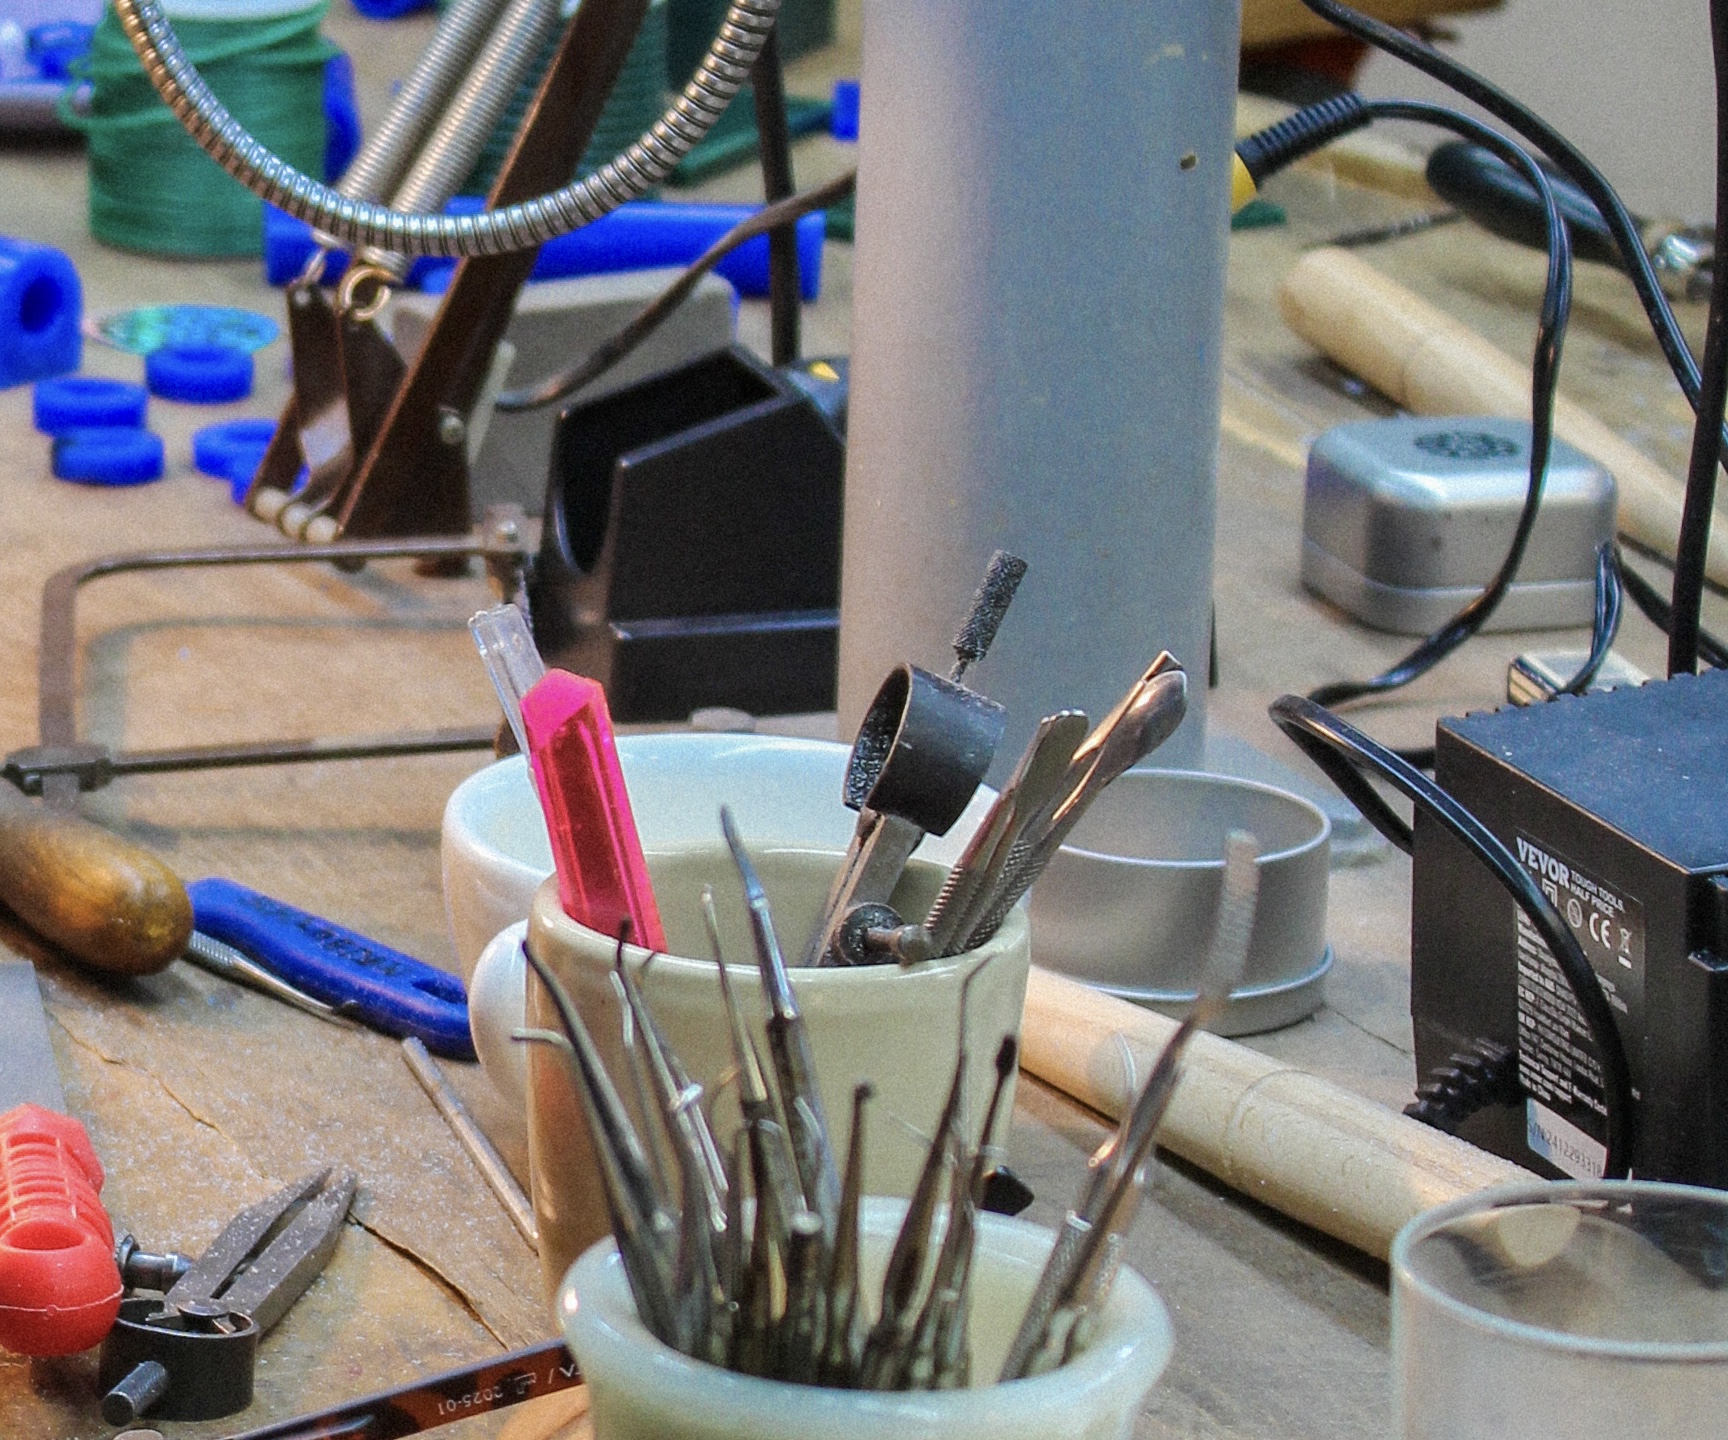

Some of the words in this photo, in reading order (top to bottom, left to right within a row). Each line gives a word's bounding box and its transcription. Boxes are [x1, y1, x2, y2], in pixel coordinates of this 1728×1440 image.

[1516, 836, 1570, 888] VEVOR
[1571, 883, 1590, 902] HALF
[1591, 896, 1615, 918] PRICE
